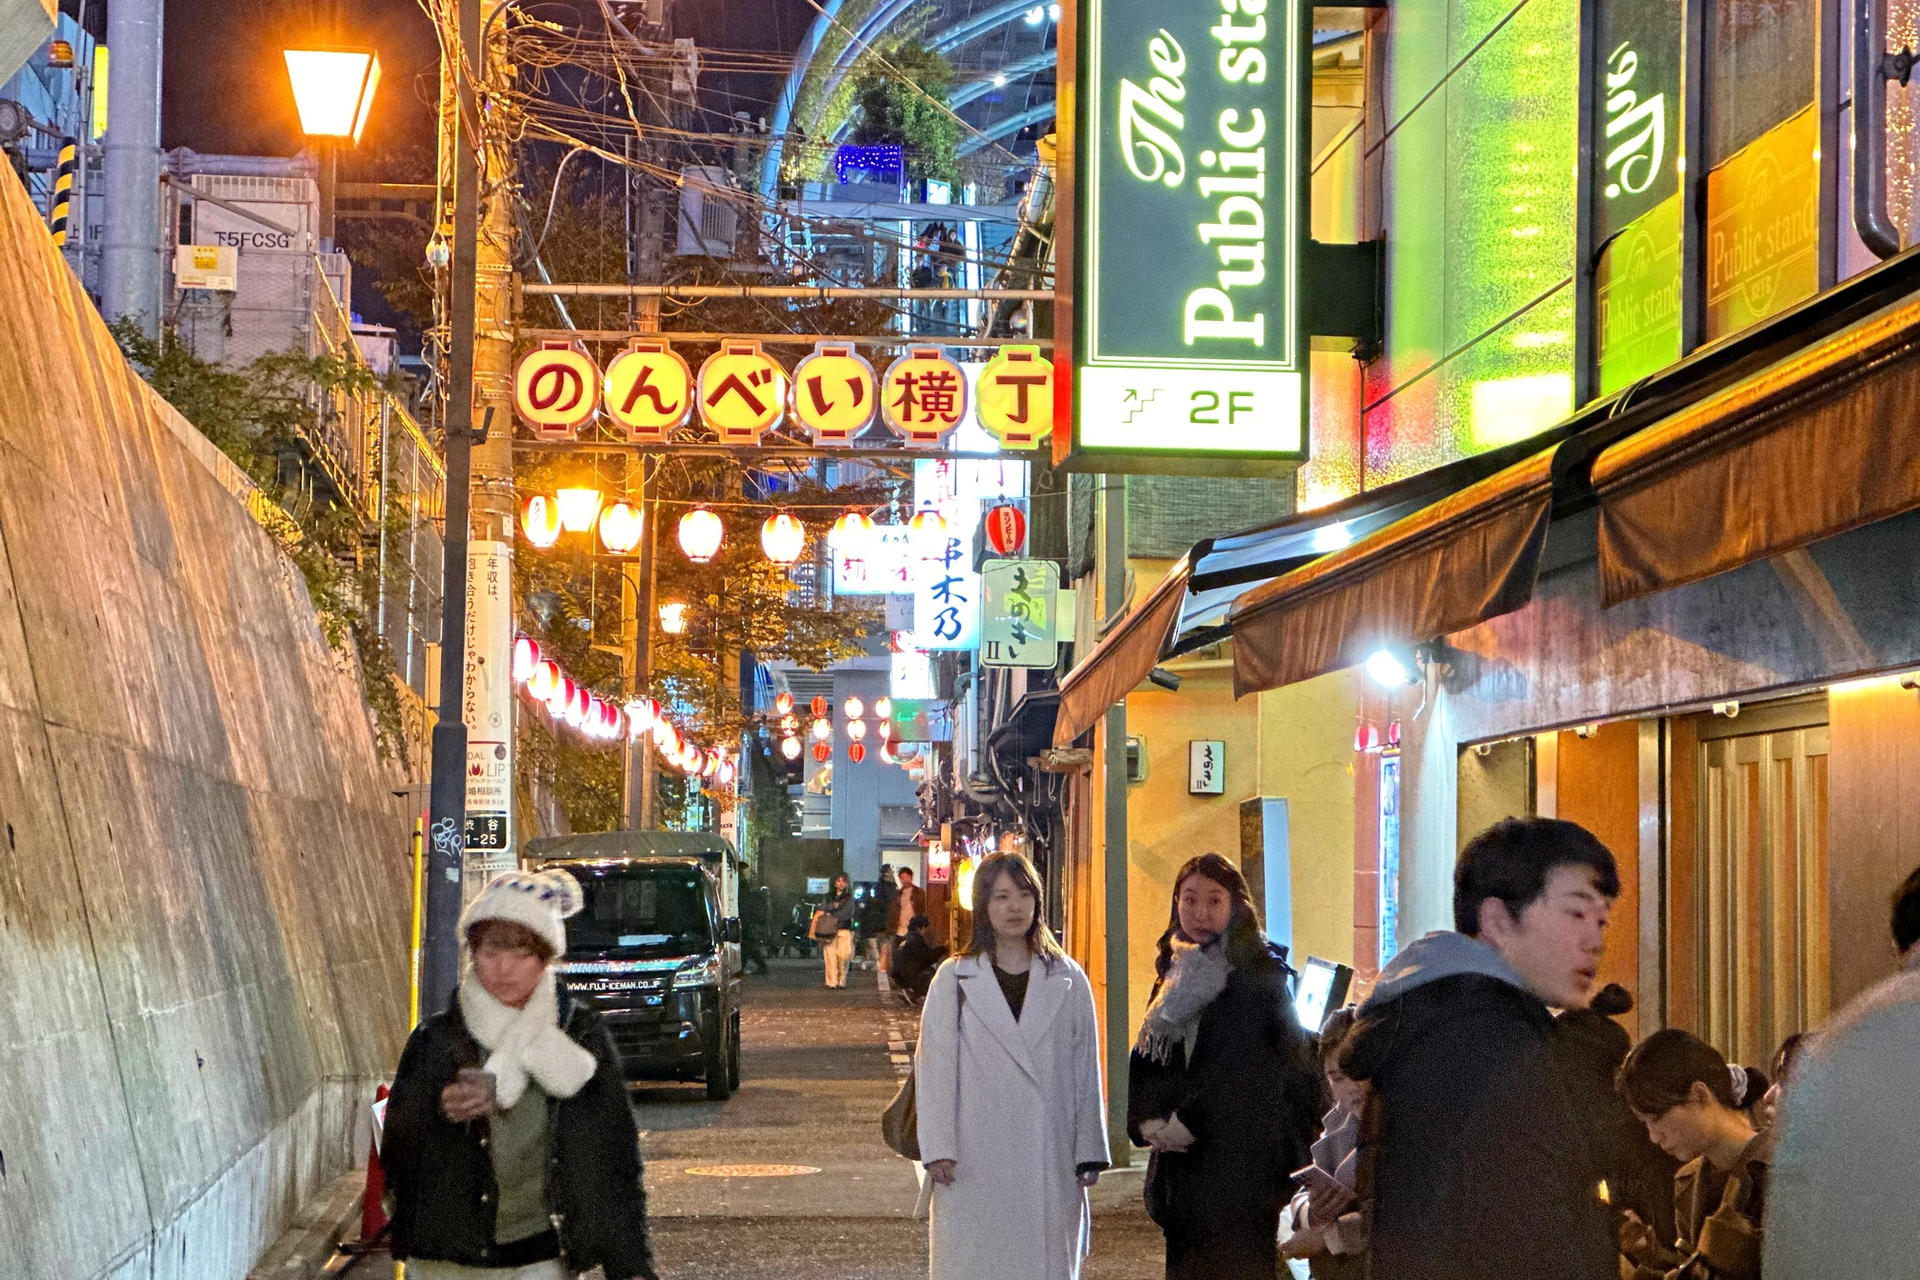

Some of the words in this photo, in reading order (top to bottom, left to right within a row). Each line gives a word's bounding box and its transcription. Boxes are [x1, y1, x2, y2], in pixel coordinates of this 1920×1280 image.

[1119, 28, 1186, 188] The
[1184, 108, 1267, 347] Public
[1712, 223, 1763, 289] Public
[1766, 193, 1815, 259] stand
[1601, 294, 1641, 351] Public
[527, 362, 1048, 424] のんべい横丁
[1189, 390, 1255, 426] 2F
[487, 557, 499, 602] 年収は、
[566, 980, 661, 991] WWW.FUJI-ICEMAN.CO.JP
[567, 962, 605, 974] ICEMAN
